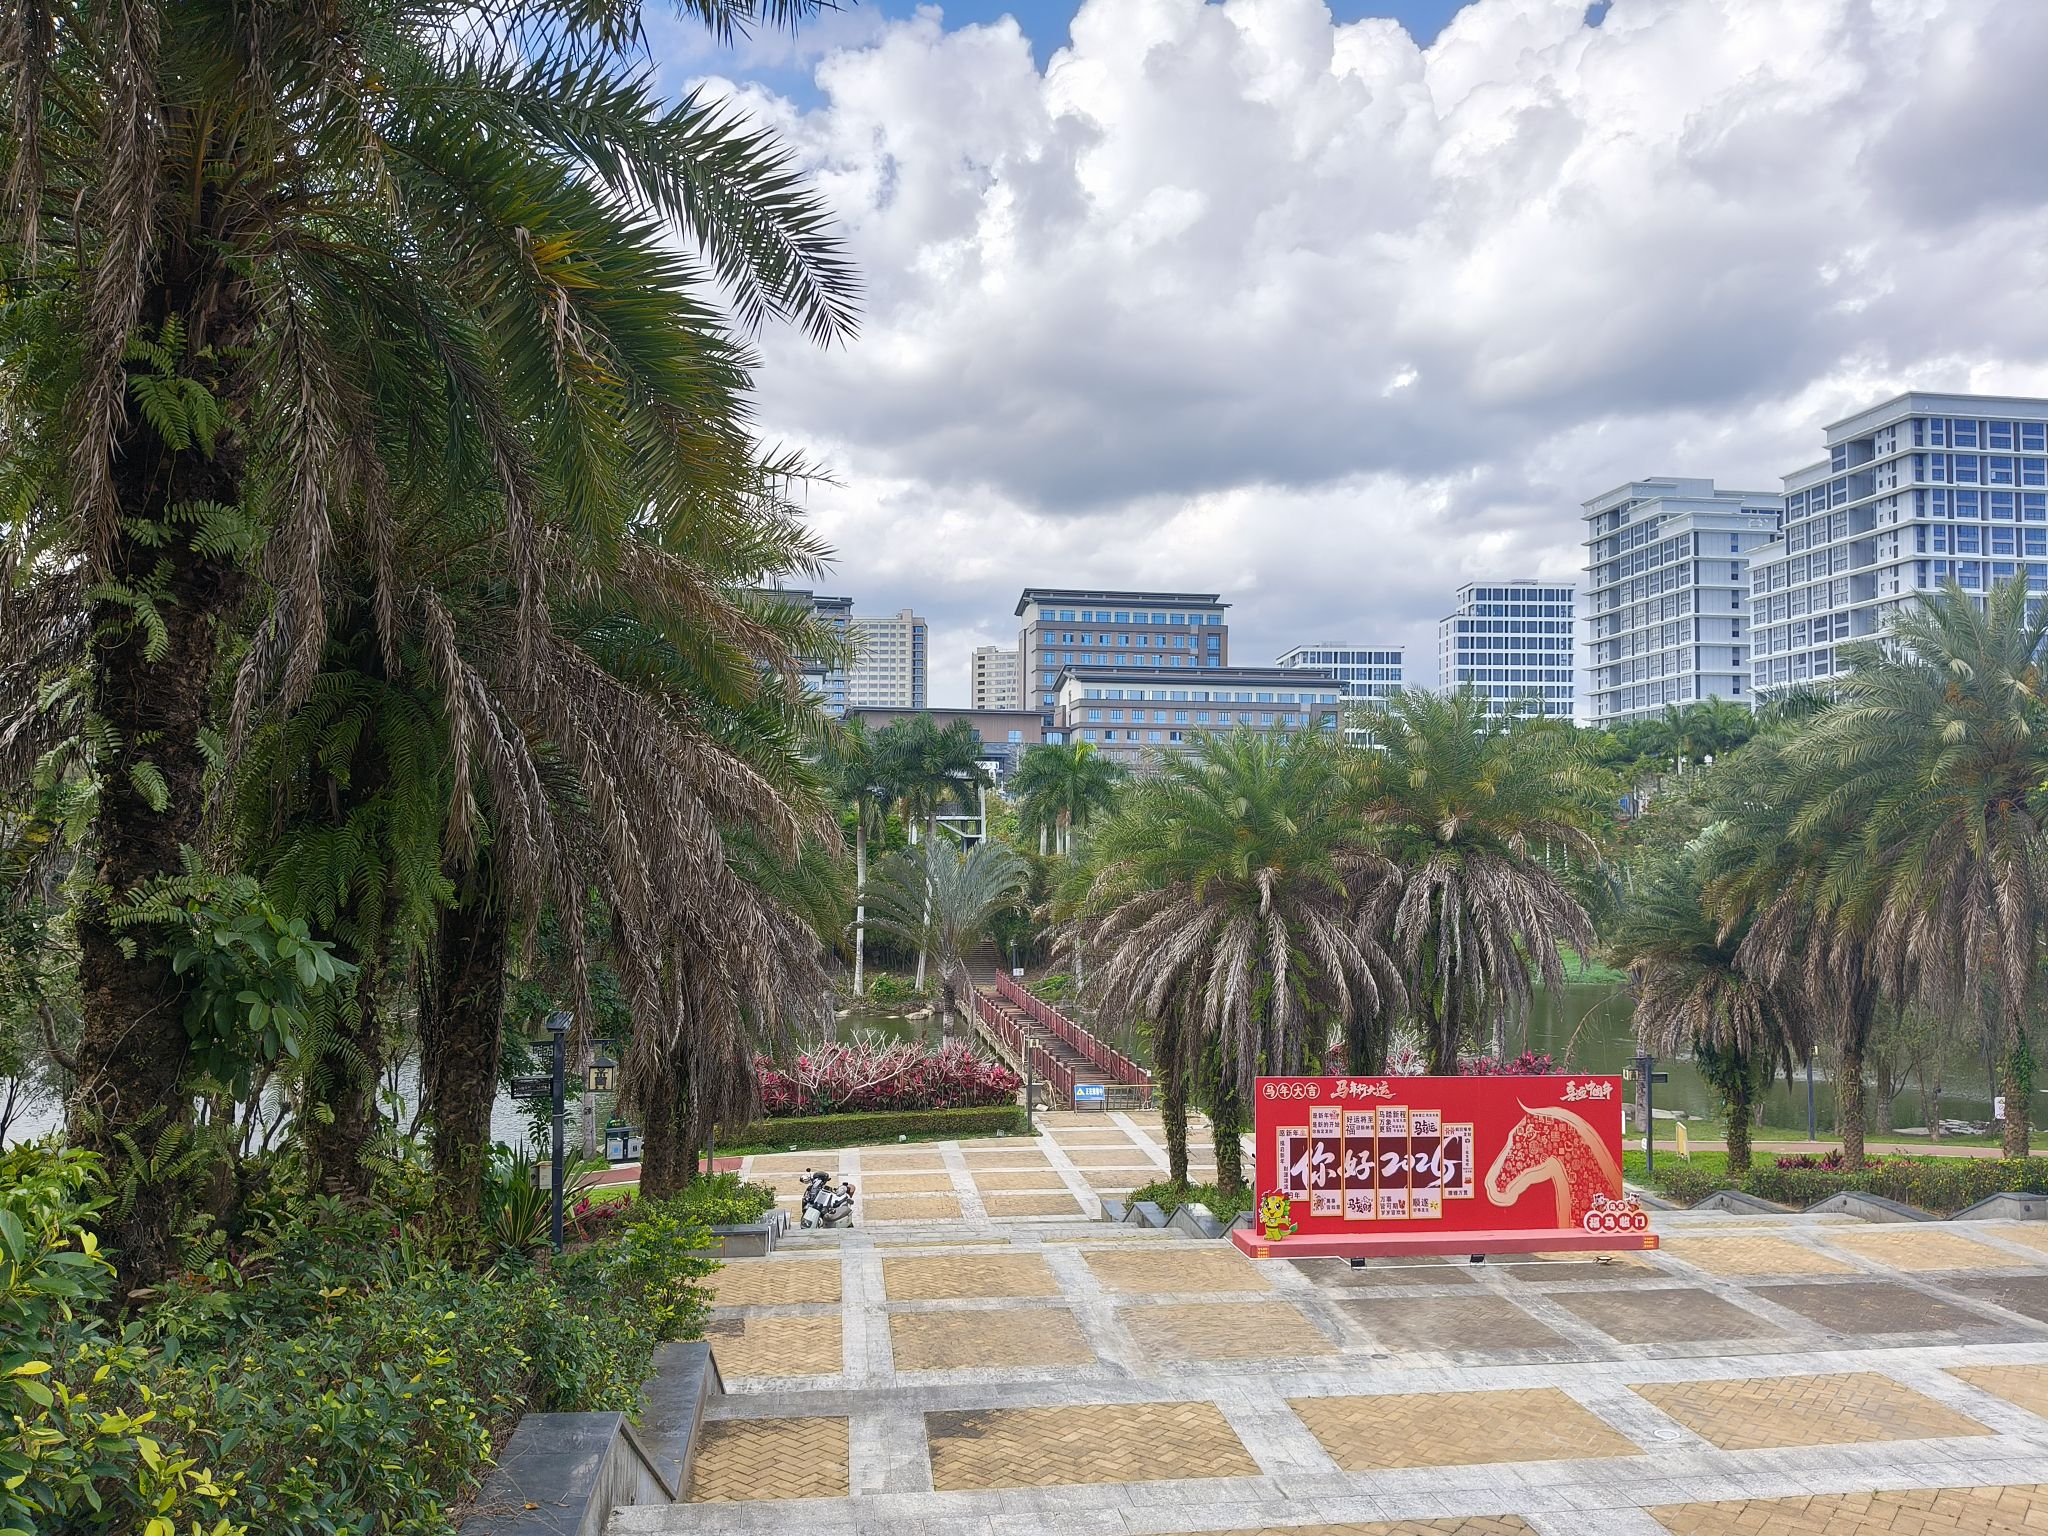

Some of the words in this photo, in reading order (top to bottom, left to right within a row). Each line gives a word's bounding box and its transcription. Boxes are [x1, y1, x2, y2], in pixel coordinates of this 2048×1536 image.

[1263, 1083, 1320, 1099] 马年大吉
[1346, 1115, 1374, 1123] 好运将至
[1588, 1215, 1646, 1230] 福马临门
